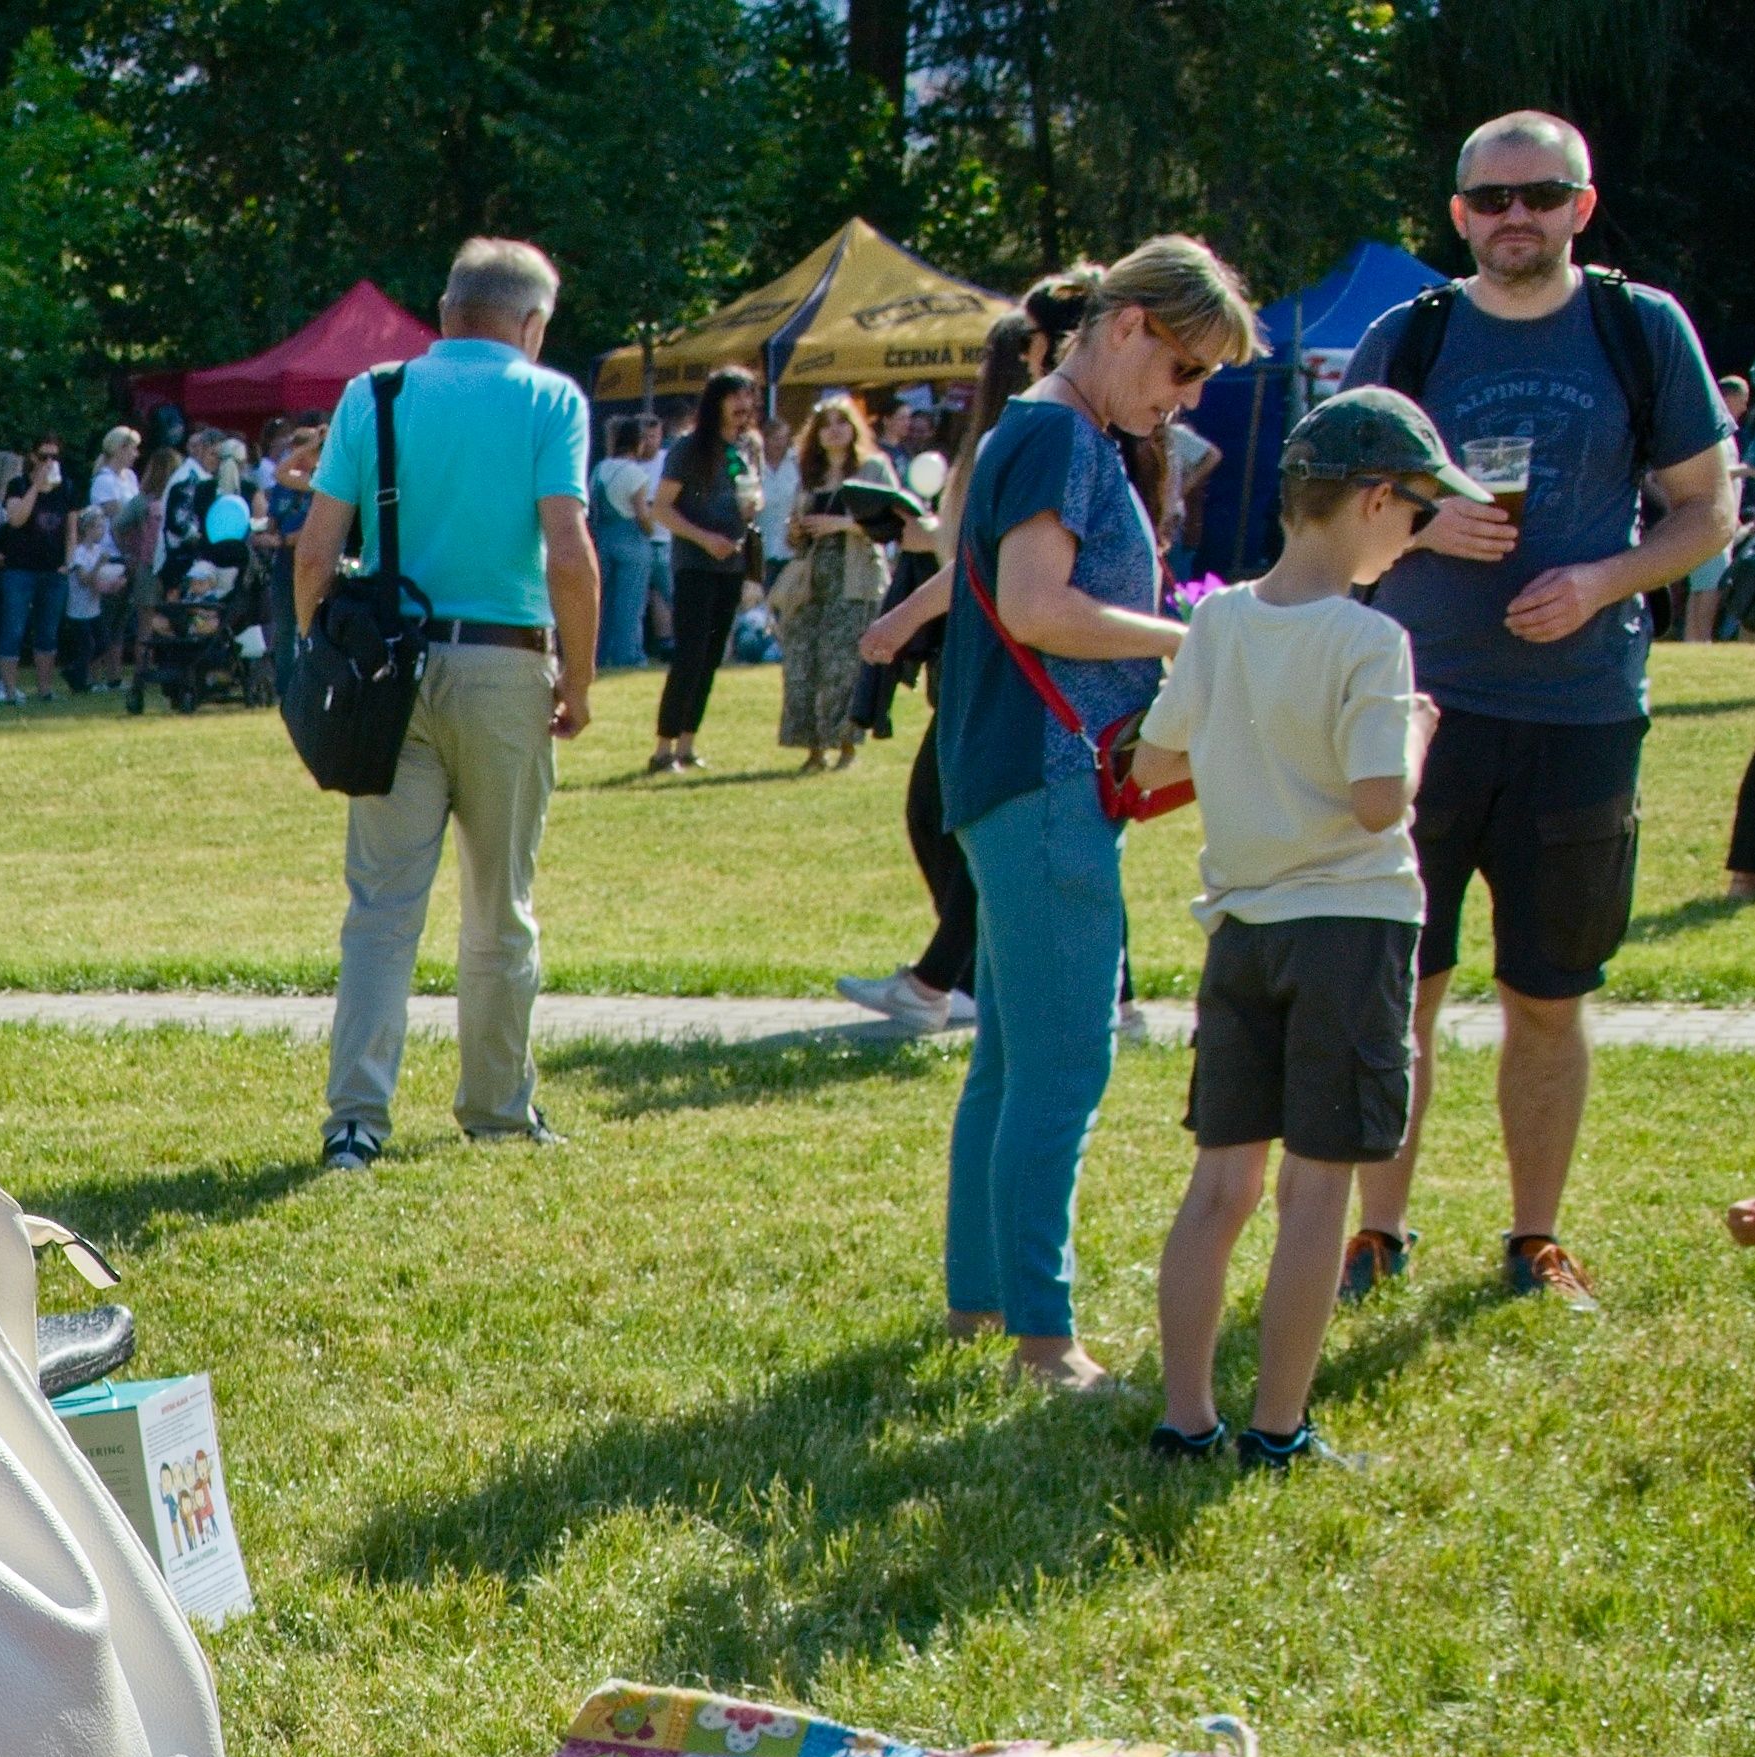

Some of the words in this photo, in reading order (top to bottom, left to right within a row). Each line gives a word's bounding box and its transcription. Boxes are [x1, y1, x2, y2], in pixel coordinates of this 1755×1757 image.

[1455, 380, 1541, 419] ALPINE
[1547, 381, 1595, 409] PRO
[86, 1444, 125, 1457] ERING
